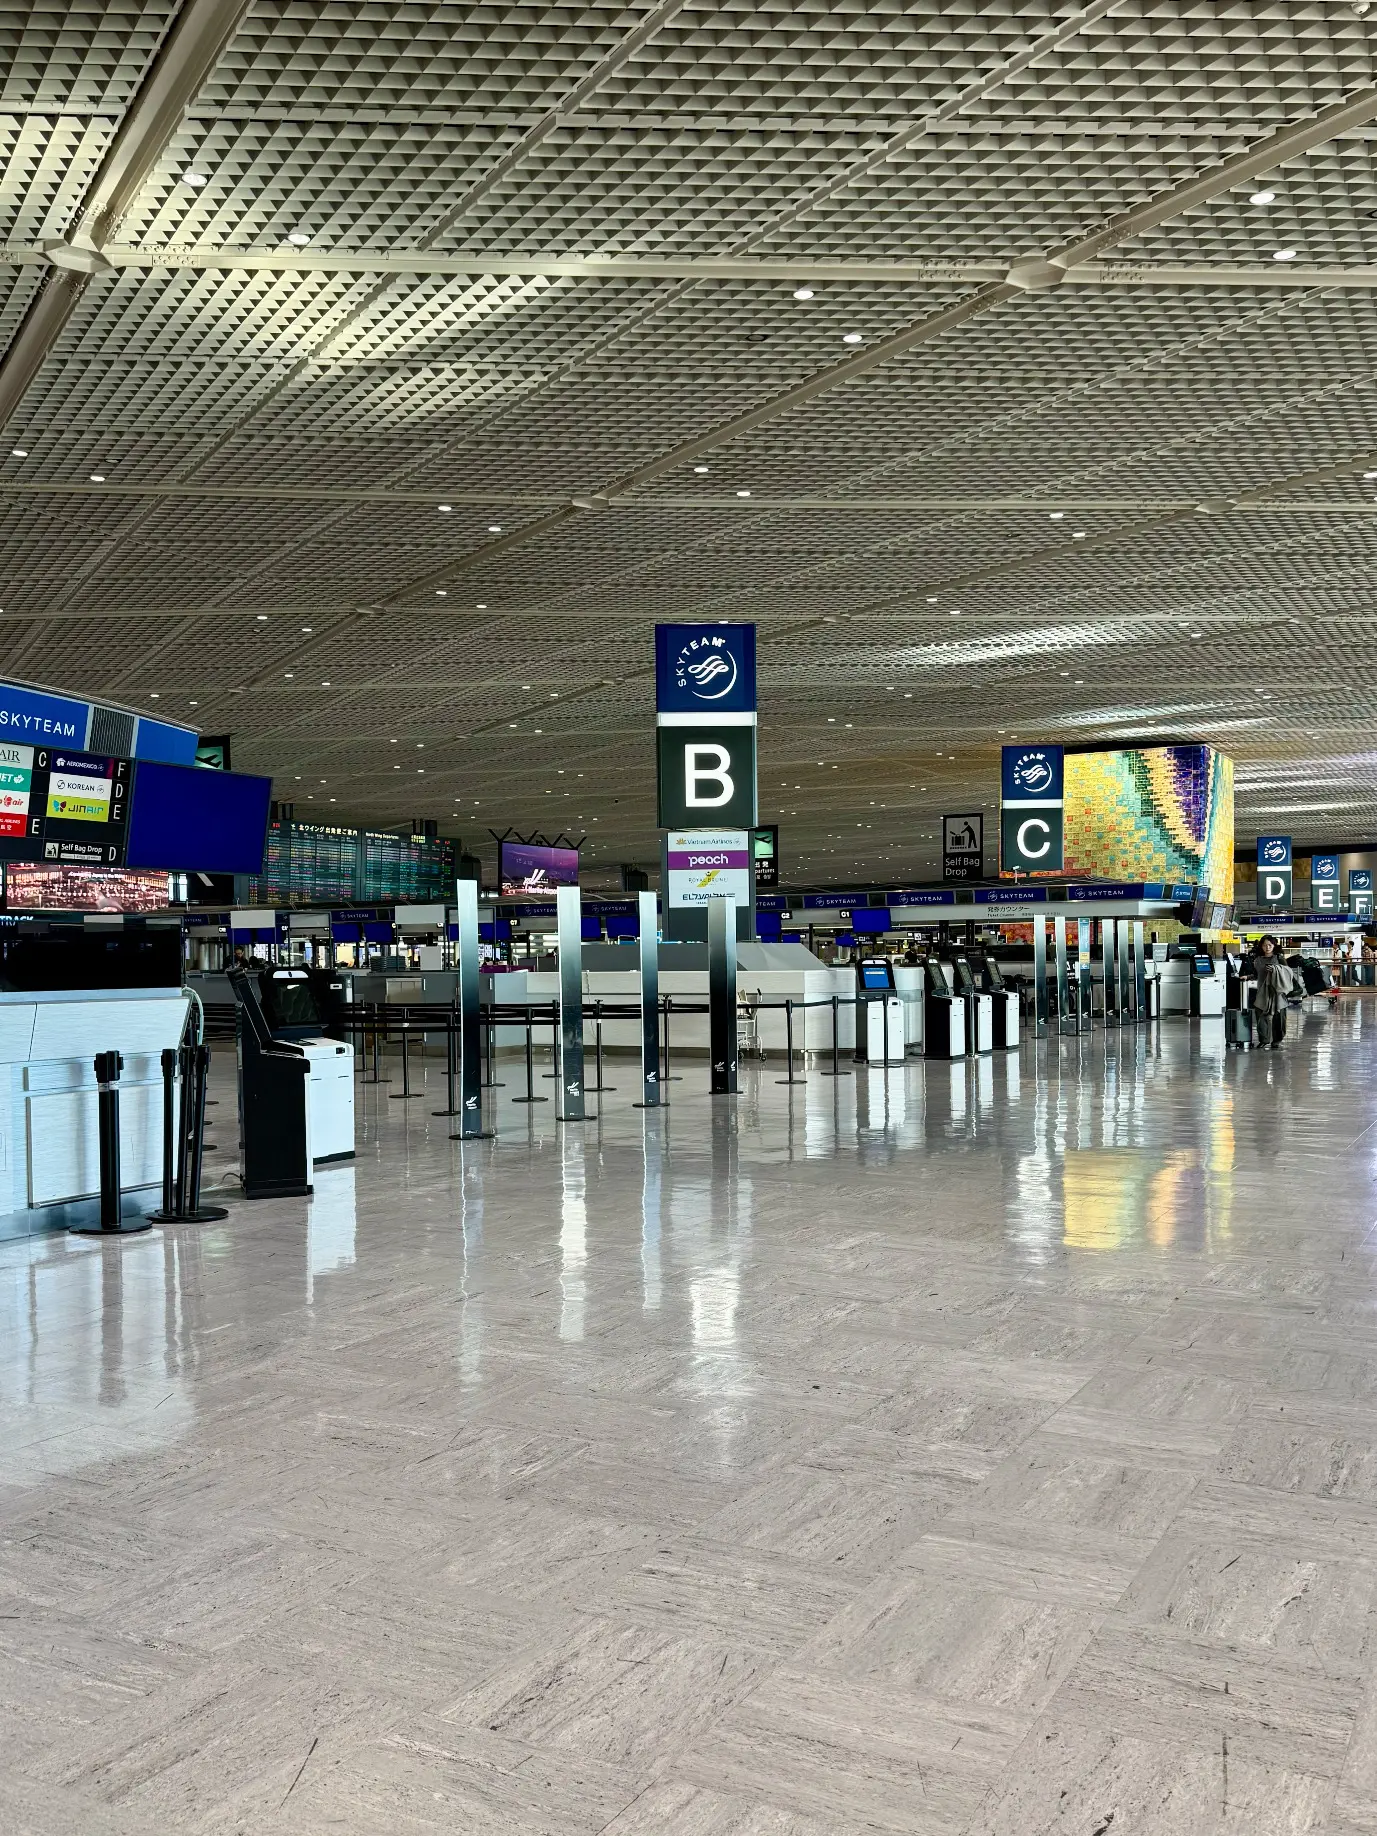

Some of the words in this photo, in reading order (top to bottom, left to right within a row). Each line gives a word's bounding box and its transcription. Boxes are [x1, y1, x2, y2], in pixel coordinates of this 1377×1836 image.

[675, 636, 726, 687] SKYTEAM
[0, 711, 75, 737] SKYTEAM
[38, 752, 47, 767] C
[66, 760, 98, 770] AEROMEXICO
[117, 762, 126, 777] F
[684, 744, 735, 807] B
[1013, 753, 1045, 785] SKYTEAM
[67, 782, 95, 792] KOREAN
[115, 783, 124, 798] D
[113, 804, 122, 820] E
[31, 818, 41, 834] E
[1016, 818, 1051, 859] C
[61, 843, 74, 851] Self
[74, 844, 87, 854] Bag
[87, 845, 103, 855] Drop
[108, 846, 117, 861] D
[688, 853, 729, 867] peach
[945, 857, 962, 866] Self
[963, 857, 980, 867] Bag
[945, 867, 967, 877] Drop
[1265, 876, 1286, 900] D
[1318, 888, 1334, 908] E
[1355, 897, 1368, 914] F
